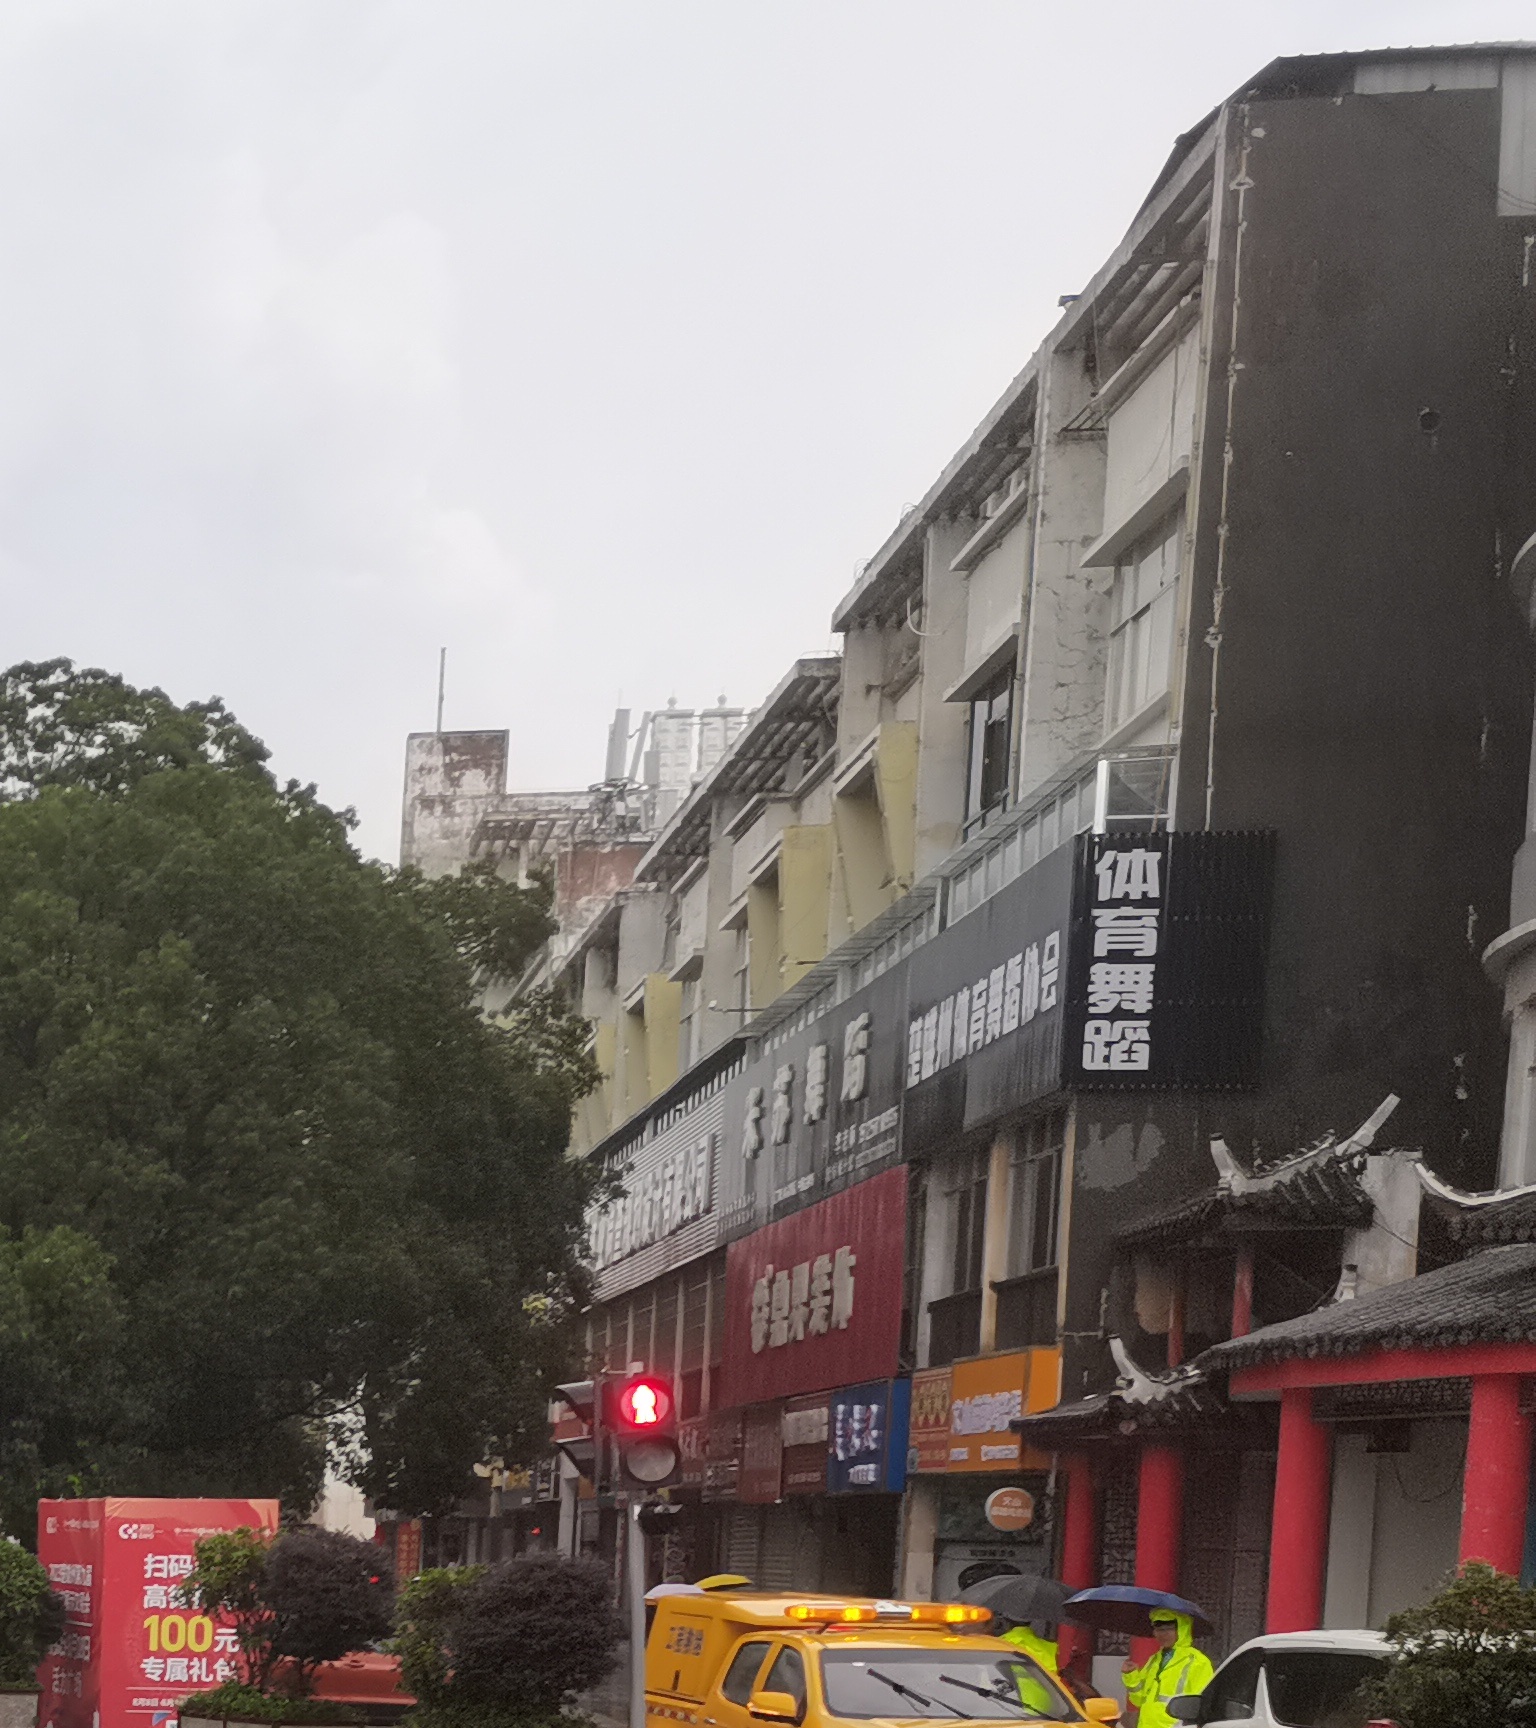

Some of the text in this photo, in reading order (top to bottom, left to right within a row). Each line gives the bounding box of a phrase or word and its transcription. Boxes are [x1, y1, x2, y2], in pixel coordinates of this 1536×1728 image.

[1082, 848, 1162, 1071] 体育舞蹈
[140, 1655, 238, 1682] 专属礼包
